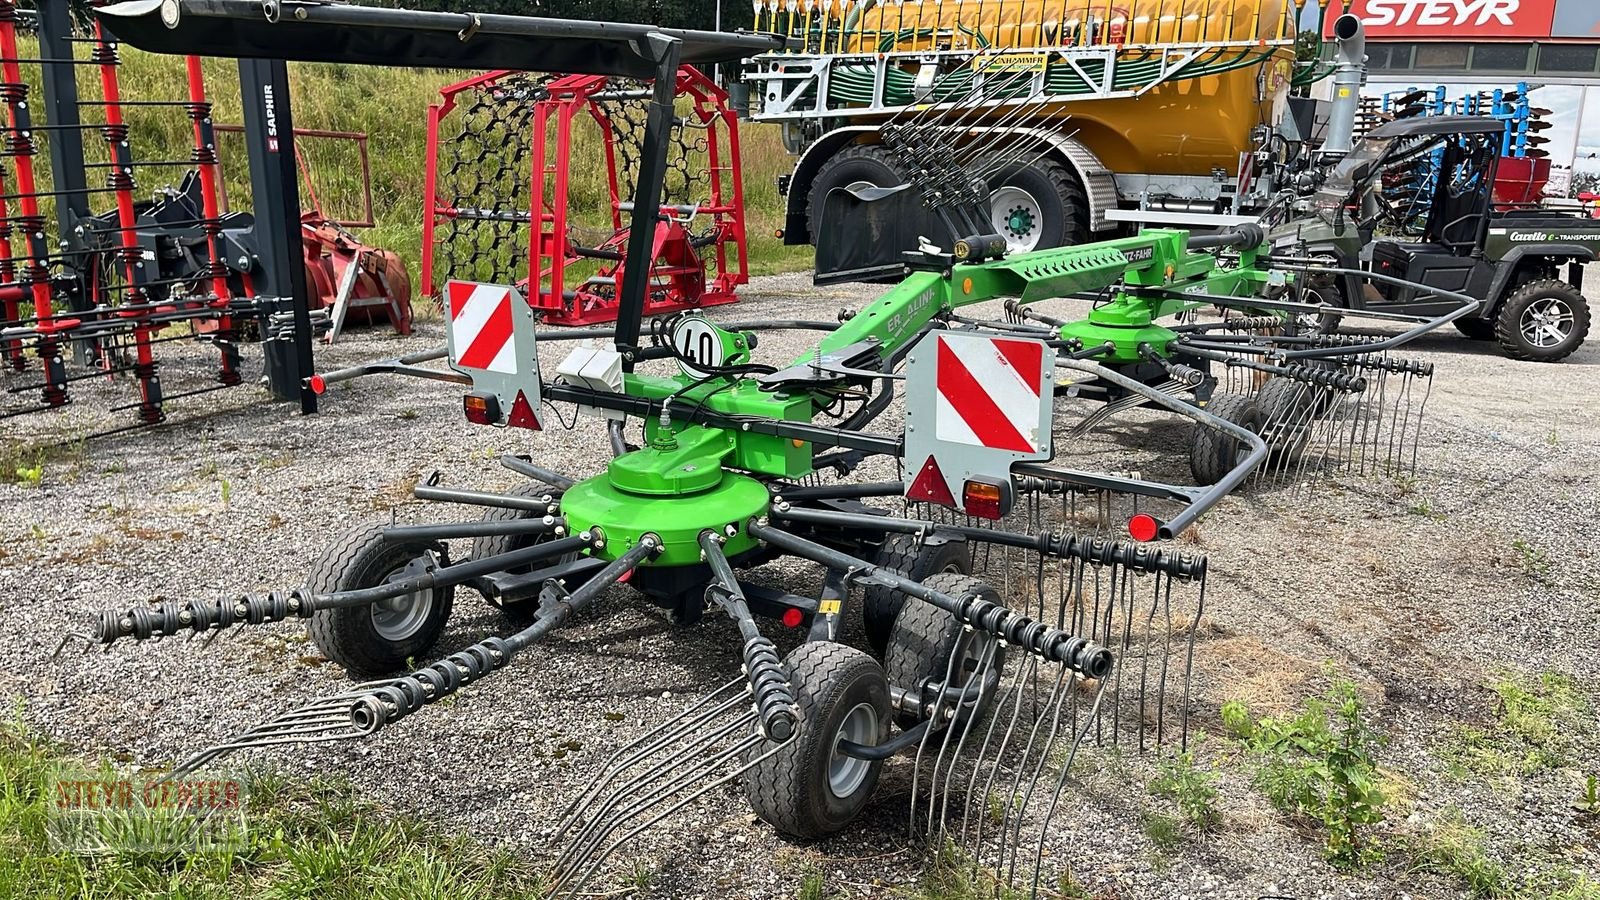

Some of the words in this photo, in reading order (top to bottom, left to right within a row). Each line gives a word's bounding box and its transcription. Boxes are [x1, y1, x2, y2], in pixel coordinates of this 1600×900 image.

[1361, 0, 1520, 26] STEYR
[264, 84, 277, 136] SAPHIR
[683, 328, 713, 367] 40
